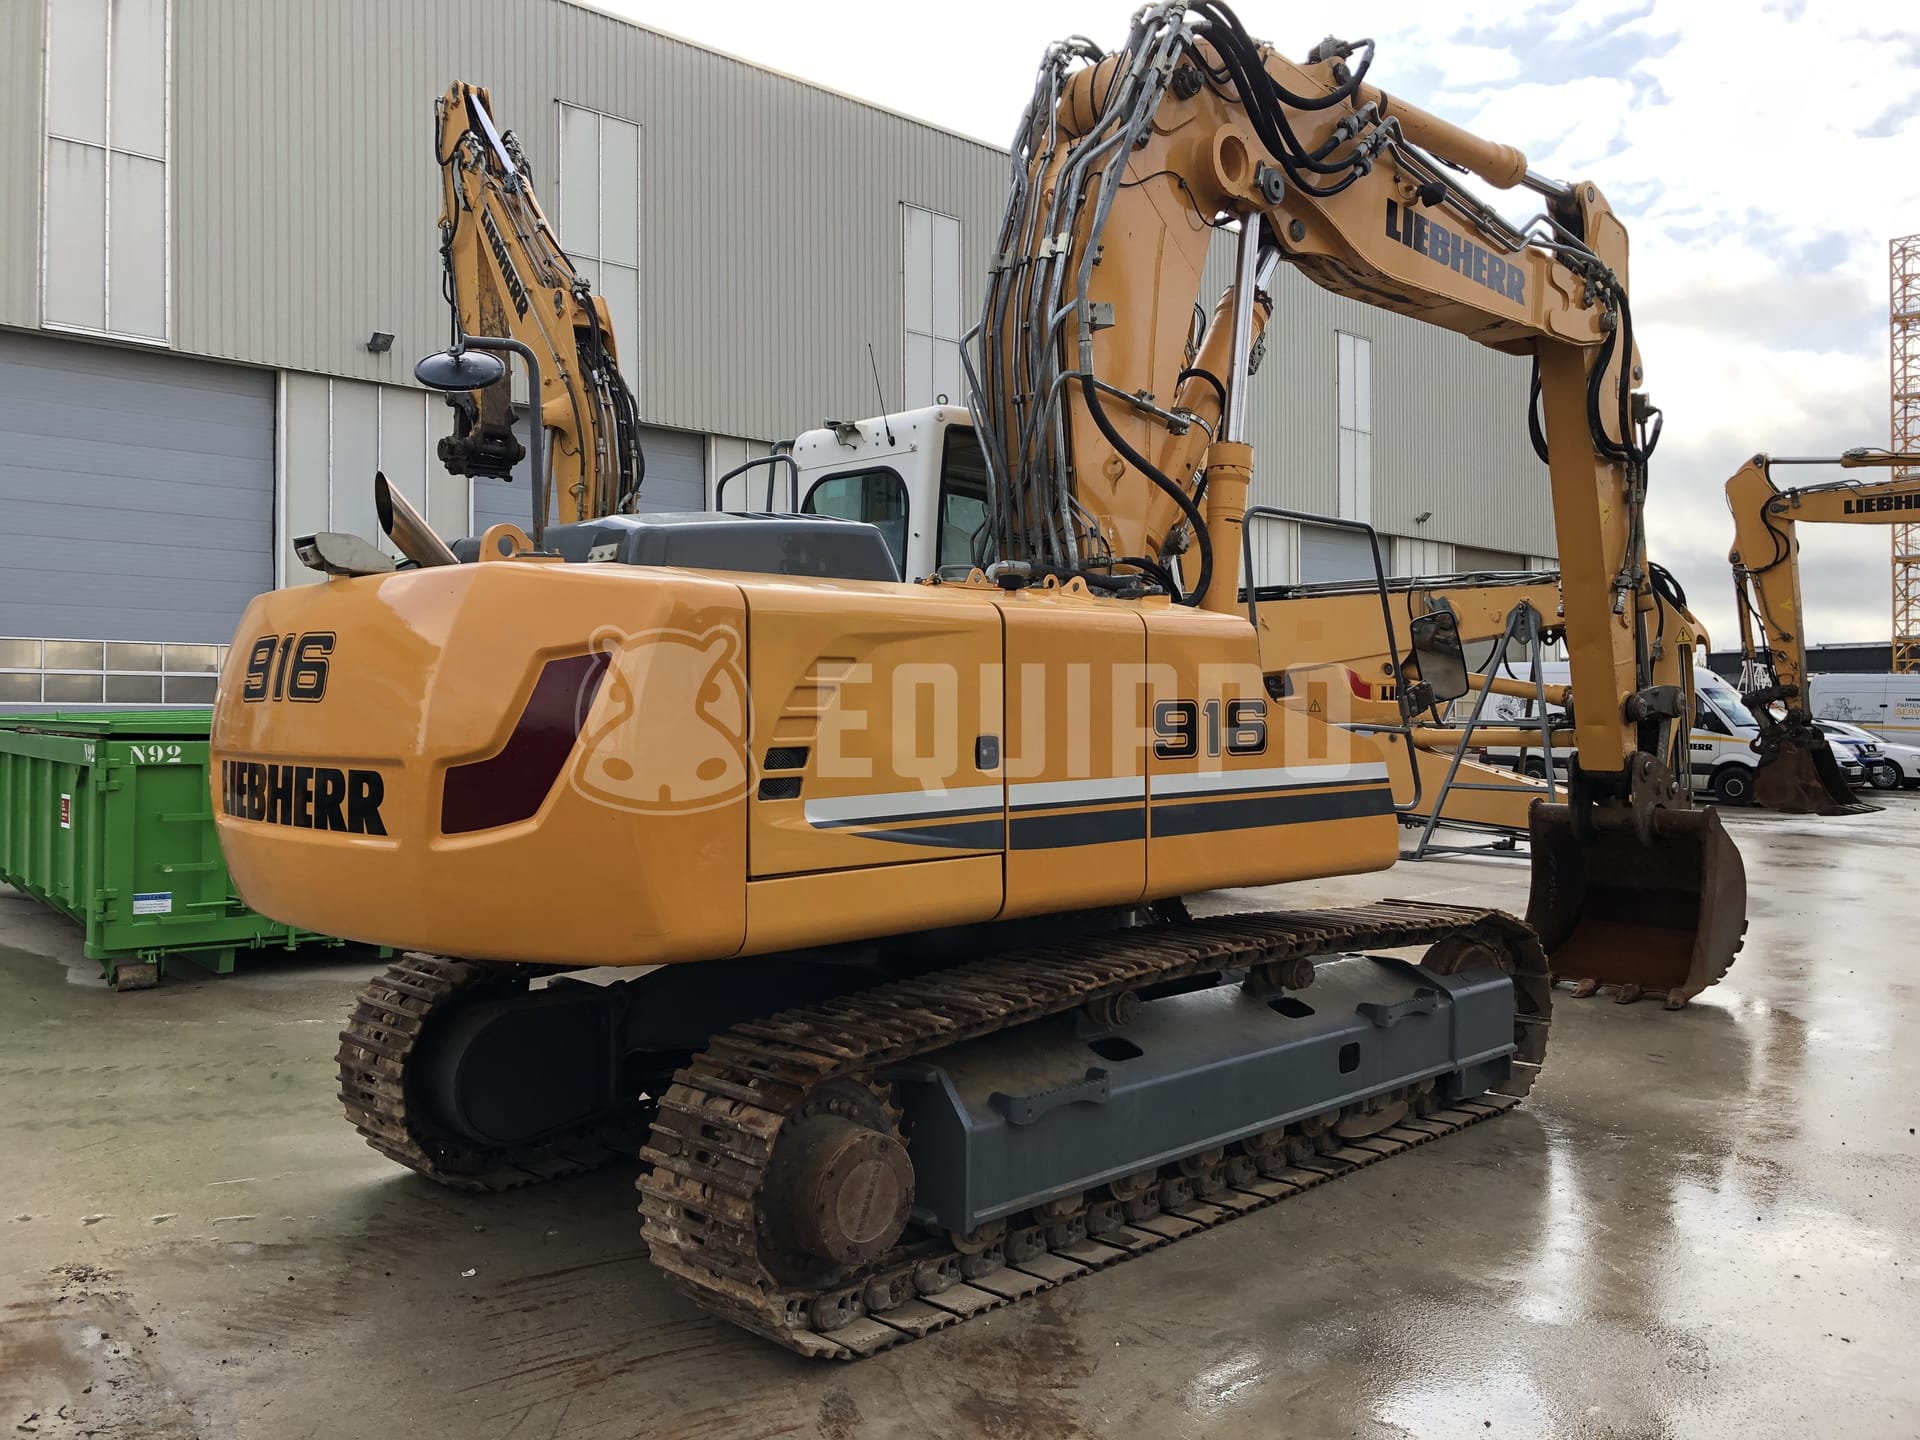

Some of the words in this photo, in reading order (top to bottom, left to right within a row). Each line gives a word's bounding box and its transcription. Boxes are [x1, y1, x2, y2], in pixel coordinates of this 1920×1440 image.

[481, 203, 529, 324] LIEBHERR
[1386, 198, 1525, 306] LIEBHERR
[243, 631, 336, 703] 916
[1381, 686, 1398, 701] LI
[129, 745, 182, 764] N92
[1153, 699, 1267, 760] 916
[222, 760, 388, 836] LIEBHERR
